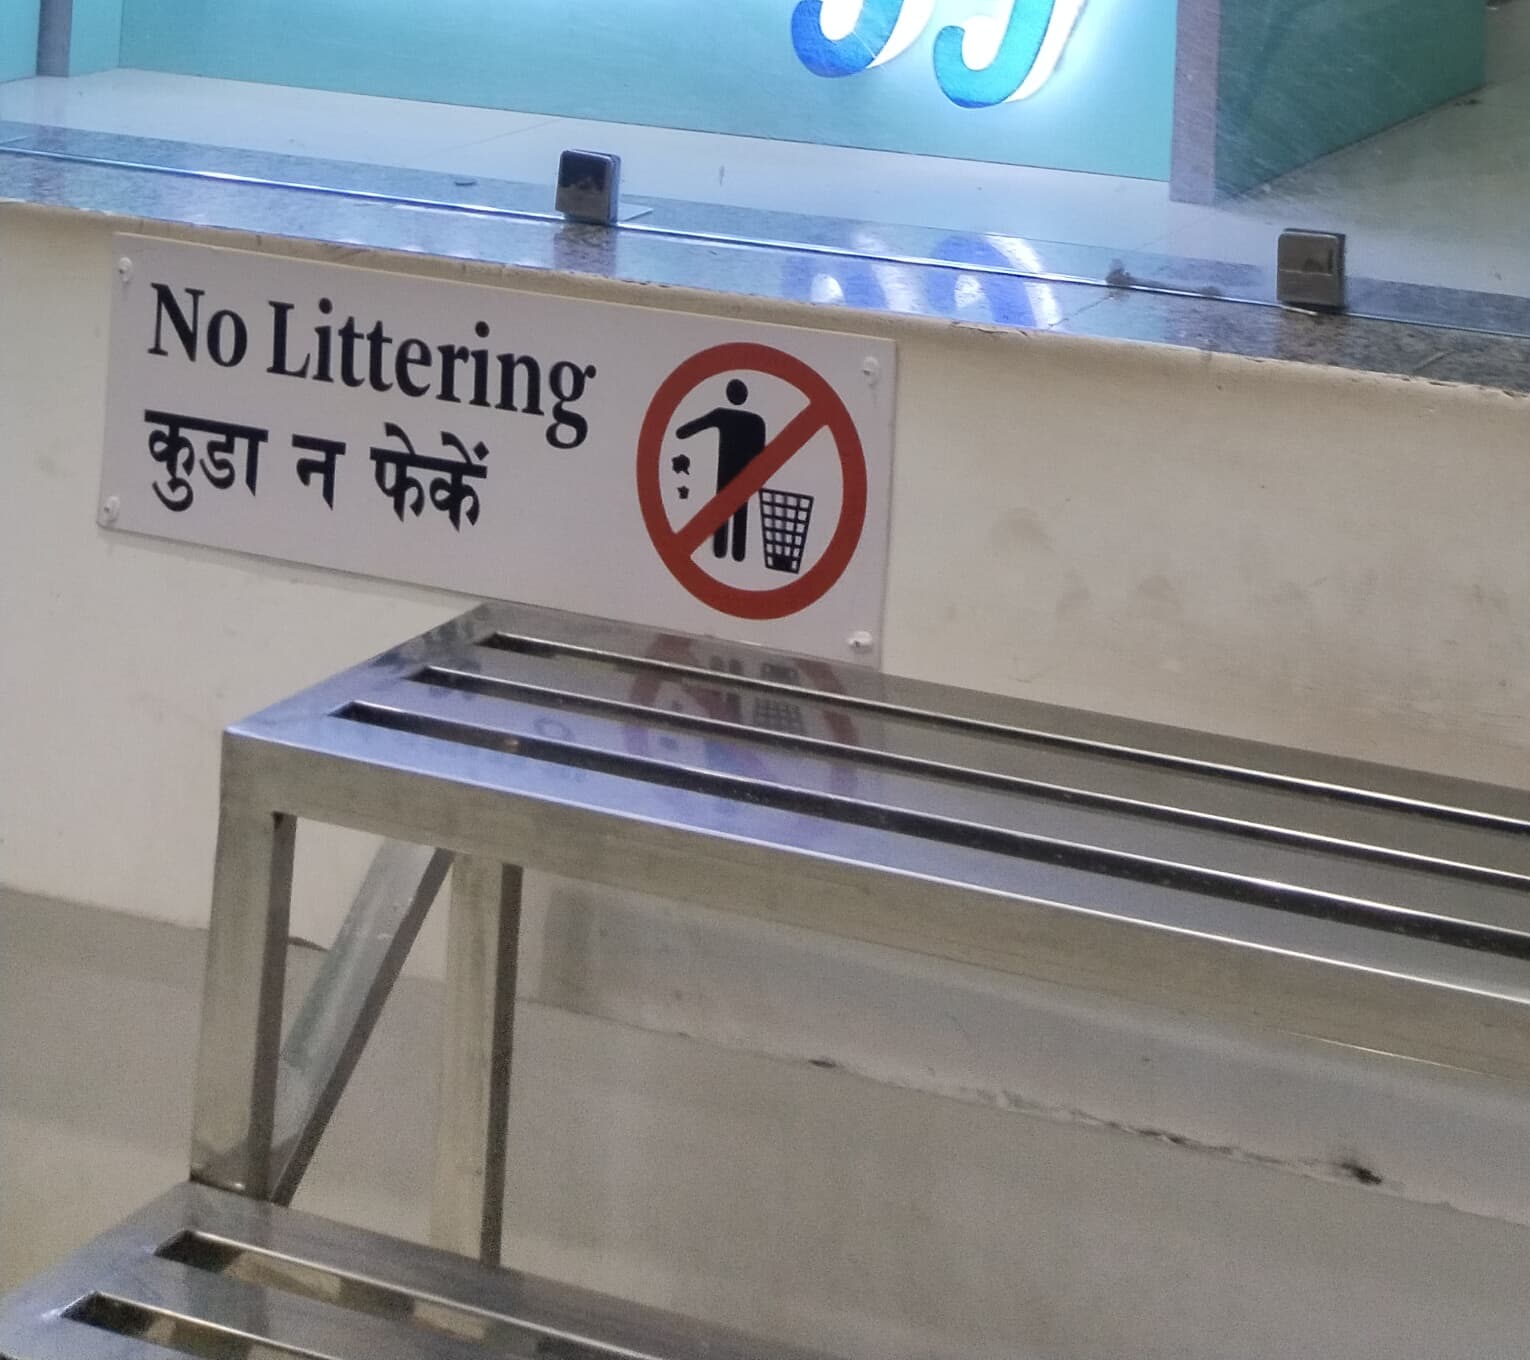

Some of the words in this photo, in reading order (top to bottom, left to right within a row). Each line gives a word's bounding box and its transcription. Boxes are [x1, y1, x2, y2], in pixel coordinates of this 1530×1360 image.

[147, 282, 249, 367] No
[266, 297, 597, 449] Littering
[143, 409, 268, 512] कुडा
[292, 433, 346, 509] न
[370, 422, 488, 532] फेकें
